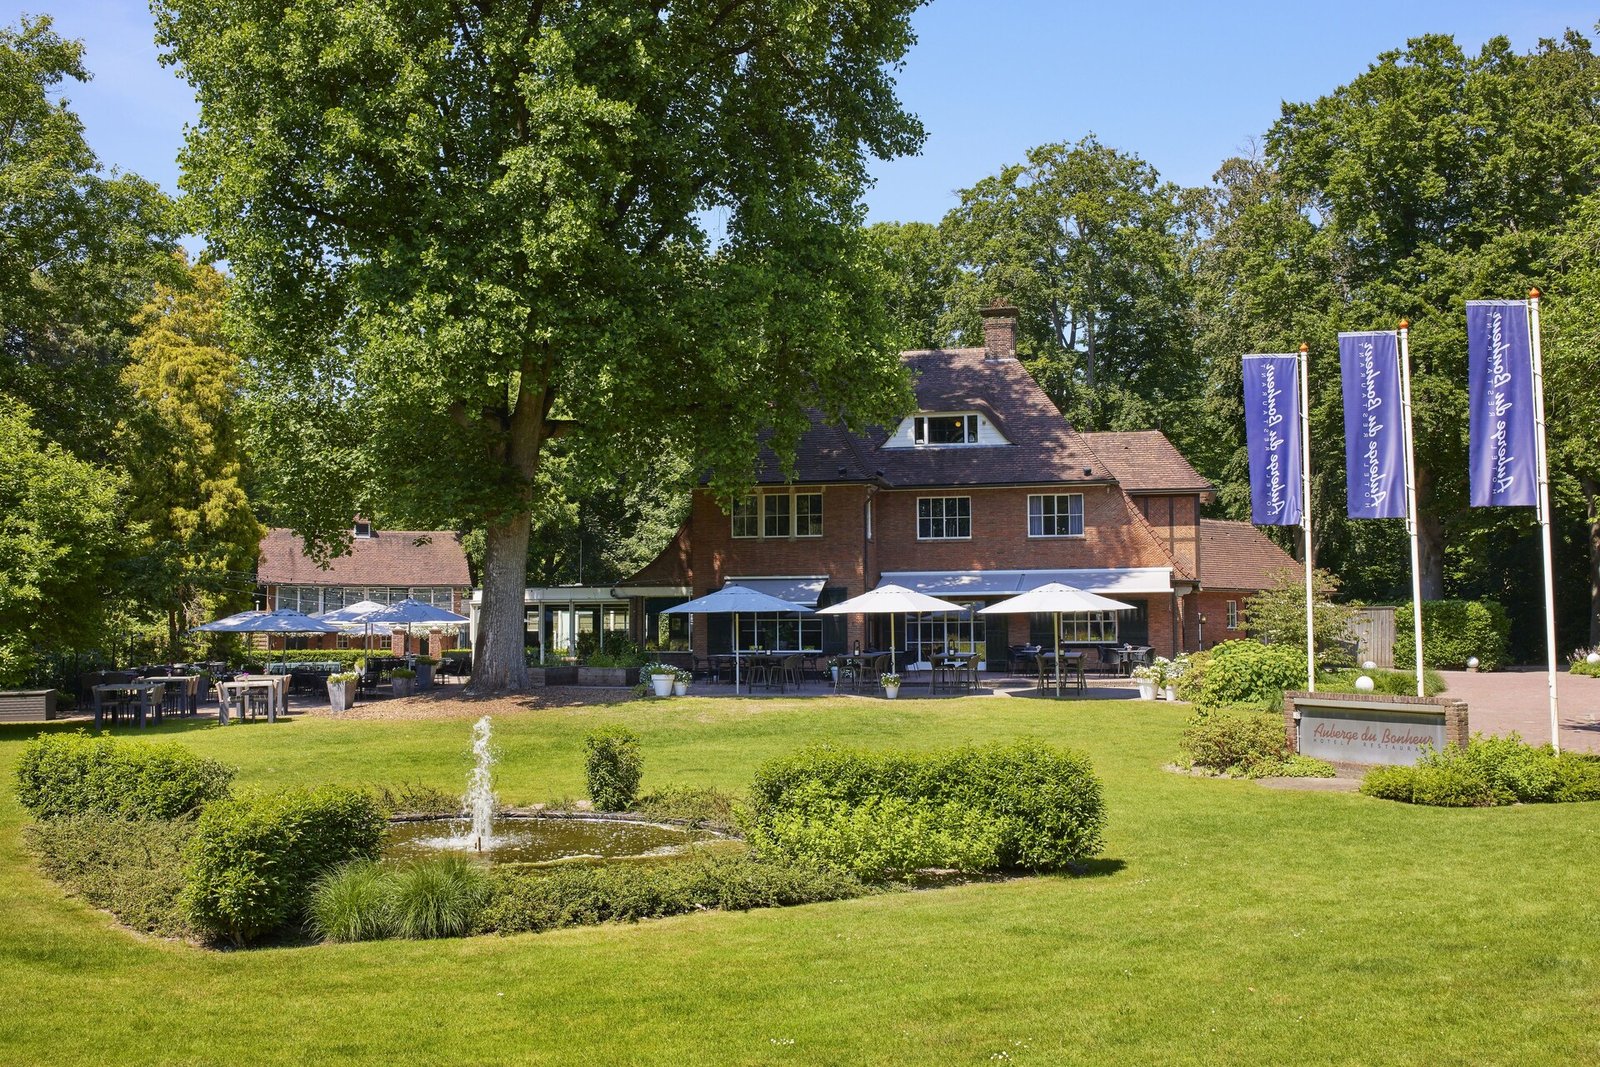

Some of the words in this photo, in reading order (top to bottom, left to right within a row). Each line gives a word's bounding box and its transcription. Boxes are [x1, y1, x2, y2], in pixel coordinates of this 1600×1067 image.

[1313, 722, 1359, 745] Auberge
[1361, 726, 1377, 742] du
[1381, 727, 1435, 745] Bonheur
